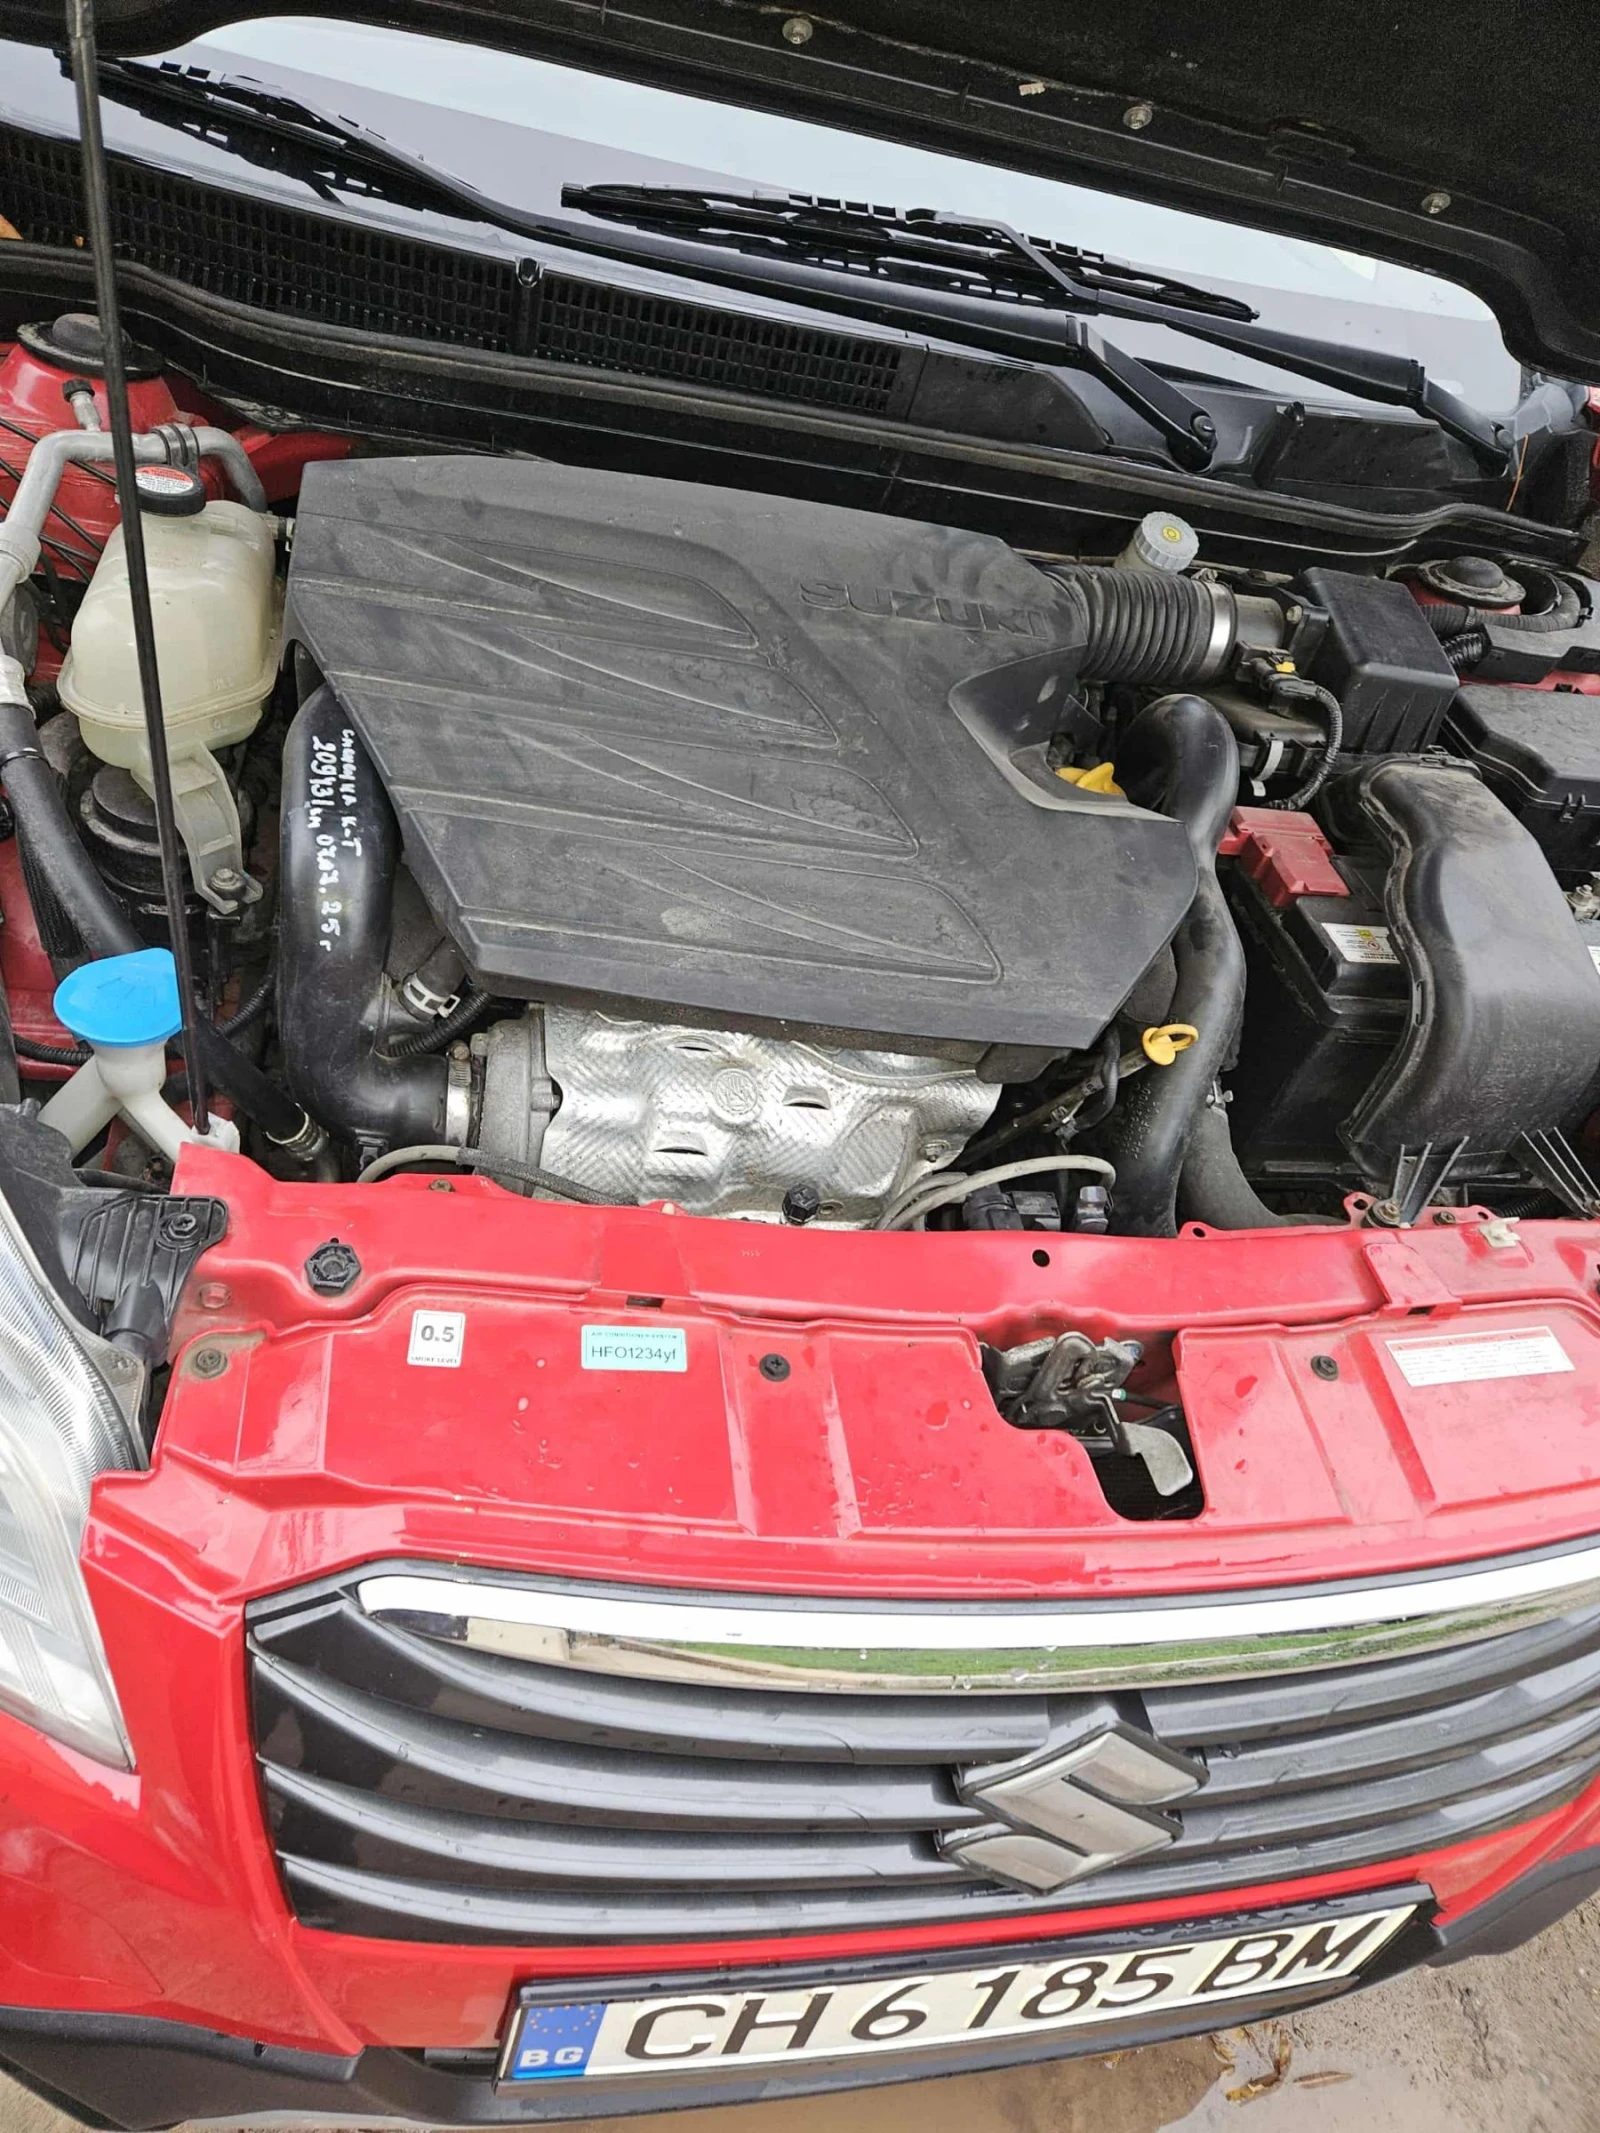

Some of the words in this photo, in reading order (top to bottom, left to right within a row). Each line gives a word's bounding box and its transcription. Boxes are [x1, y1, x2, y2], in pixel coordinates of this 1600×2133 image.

[800, 582, 1051, 640] SUZUKI
[420, 1325, 455, 1343] 0.5
[591, 1346, 677, 1363] HFO1234yf
[625, 1992, 834, 2060] CH
[1192, 1916, 1389, 1995] BM
[519, 2046, 584, 2068] BG
